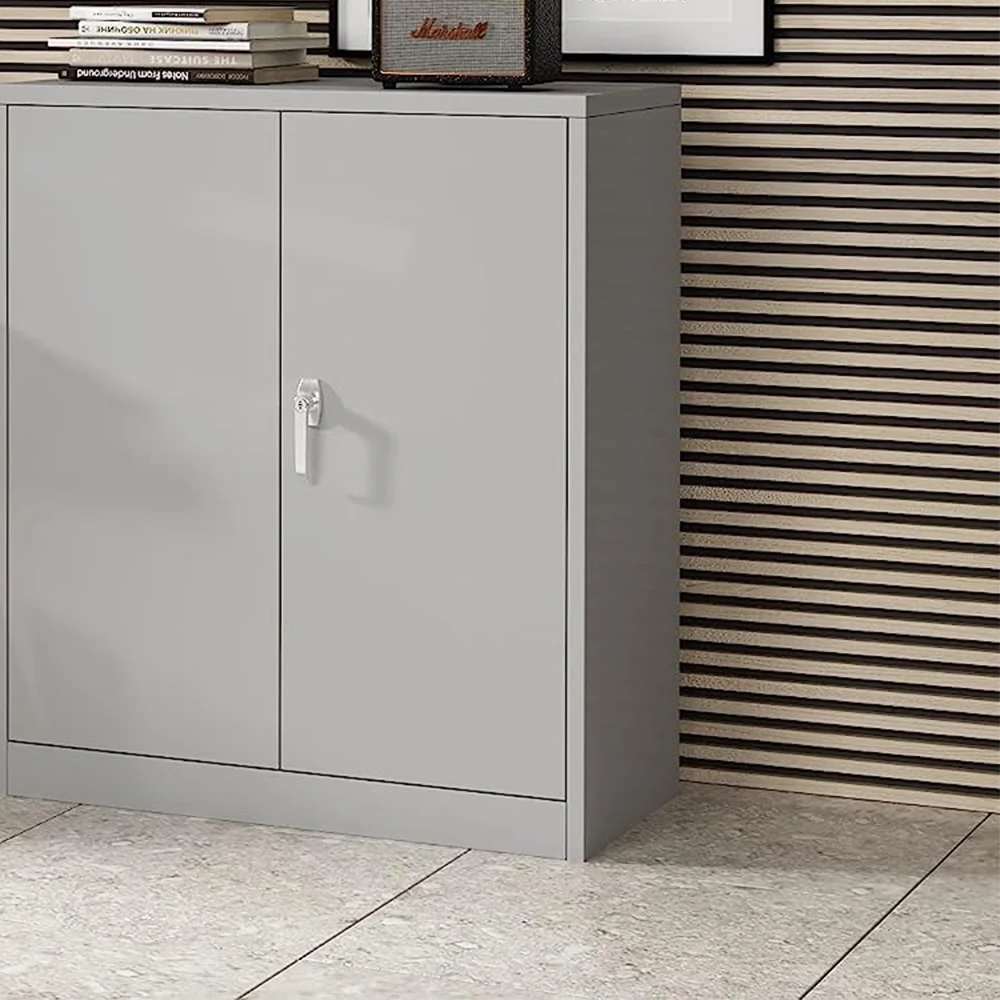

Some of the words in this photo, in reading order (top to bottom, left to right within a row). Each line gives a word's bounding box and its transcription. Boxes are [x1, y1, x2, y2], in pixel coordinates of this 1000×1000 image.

[408, 17, 489, 41] Marshall
[150, 54, 208, 65] SUITCASE
[213, 54, 238, 65] THE
[77, 67, 136, 81] Underground
[137, 70, 158, 81] From
[158, 70, 189, 81] Notes
